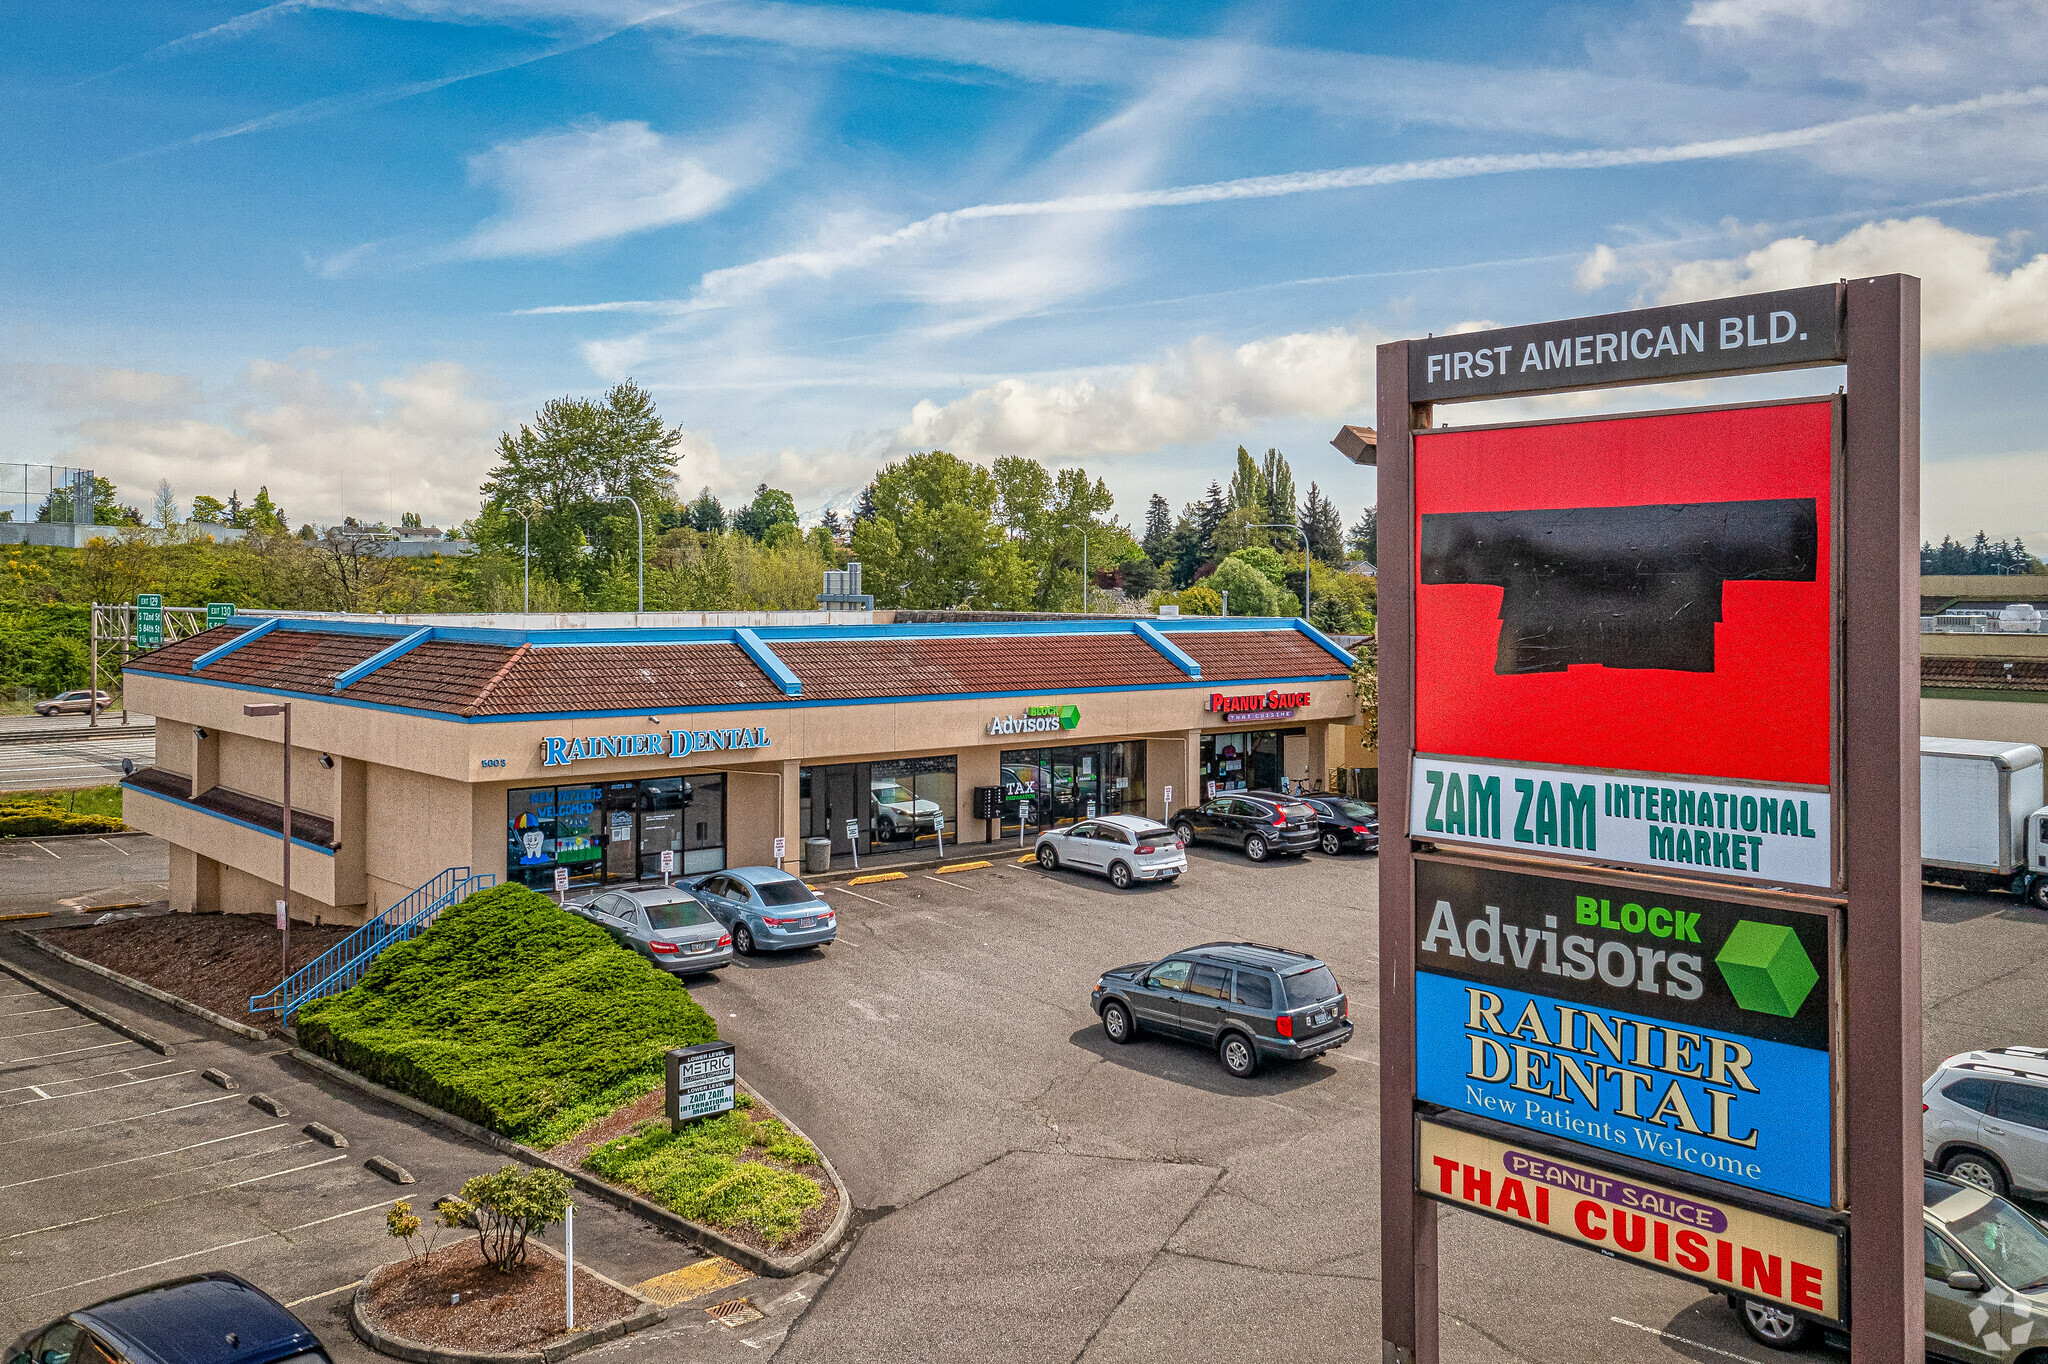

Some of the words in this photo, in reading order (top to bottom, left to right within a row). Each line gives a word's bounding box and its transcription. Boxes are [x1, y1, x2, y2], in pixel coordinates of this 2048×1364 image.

[1427, 345, 1512, 383] FIRST
[1520, 321, 1704, 372] AMERICAN
[1719, 310, 1808, 350] BLD.
[150, 597, 158, 606] 129
[138, 612, 142, 621] S
[143, 612, 154, 621] 72nd
[155, 612, 160, 621] St
[221, 606, 231, 616] 130
[138, 624, 142, 633] S
[155, 625, 160, 633] St
[1211, 692, 1265, 713] PEANUT
[1268, 689, 1311, 710] SAUCE
[1028, 705, 1059, 716] BLOCK
[1254, 711, 1291, 719] CUISINE
[990, 713, 1060, 736] Advisors
[543, 733, 665, 767] RAINIER
[667, 727, 772, 758] DENTAL
[530, 791, 554, 804] NEW
[557, 788, 603, 803] PATIENTS
[1006, 780, 1035, 796] TAX
[537, 803, 594, 818] WELCOMED
[1425, 770, 1501, 840] ZAM
[1513, 777, 1597, 852] ZAM
[1604, 782, 1816, 839] INTERNATIONAL
[1649, 825, 1763, 873] MARKET
[1575, 895, 1702, 944] BLOCK
[1421, 900, 1704, 1001] Advisors
[1464, 987, 1760, 1093] RAINIER
[688, 1054, 707, 1062] LOWER
[683, 1057, 730, 1076] METRIC
[684, 1074, 706, 1082] CLOTHING
[707, 1069, 729, 1077] COMPANY
[688, 1086, 707, 1094] LOWER
[690, 1093, 705, 1104] ZAM
[708, 1089, 724, 1100] ZAM
[1465, 1033, 1759, 1149] DENTAL
[681, 1097, 732, 1112] INTERNATIONAL
[693, 1105, 720, 1115] MARKET
[1466, 1084, 1517, 1115] New
[1524, 1100, 1627, 1145] Patients
[1632, 1126, 1763, 1181] Welcome
[1511, 1156, 1613, 1198] PEANUT
[1621, 1187, 1715, 1228] SAUCE
[1433, 1155, 1550, 1226] THAI
[1573, 1200, 1824, 1311] CUISINE
